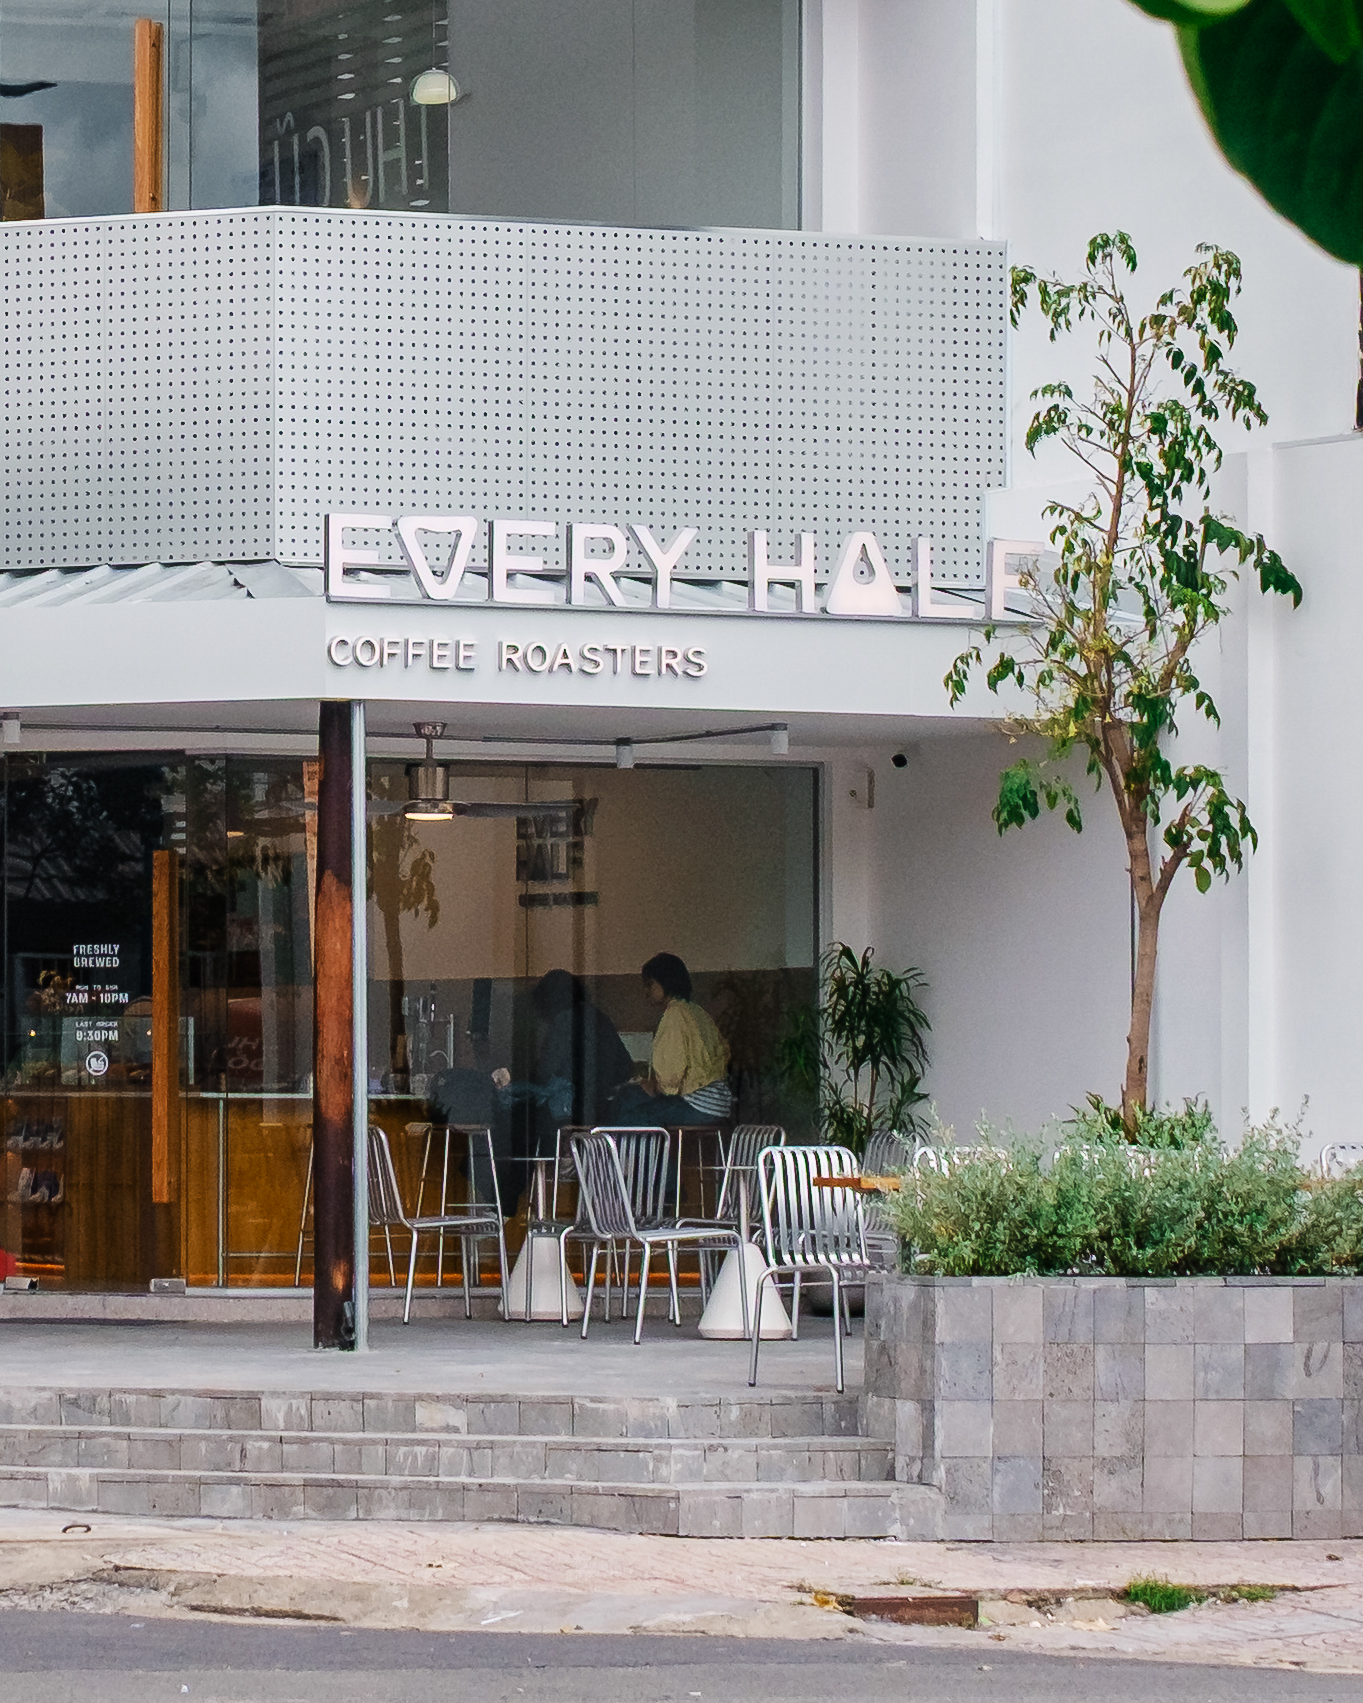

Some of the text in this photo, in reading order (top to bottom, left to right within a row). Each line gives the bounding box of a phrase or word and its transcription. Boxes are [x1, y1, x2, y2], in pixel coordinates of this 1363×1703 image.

[323, 512, 1046, 622] EVERY HALF
[326, 635, 710, 678] COFFEE ROASTERS
[72, 944, 120, 956] FRESHLY
[73, 956, 120, 968] BREWED
[65, 992, 89, 1004] 7AM
[99, 992, 129, 1004] 10PM
